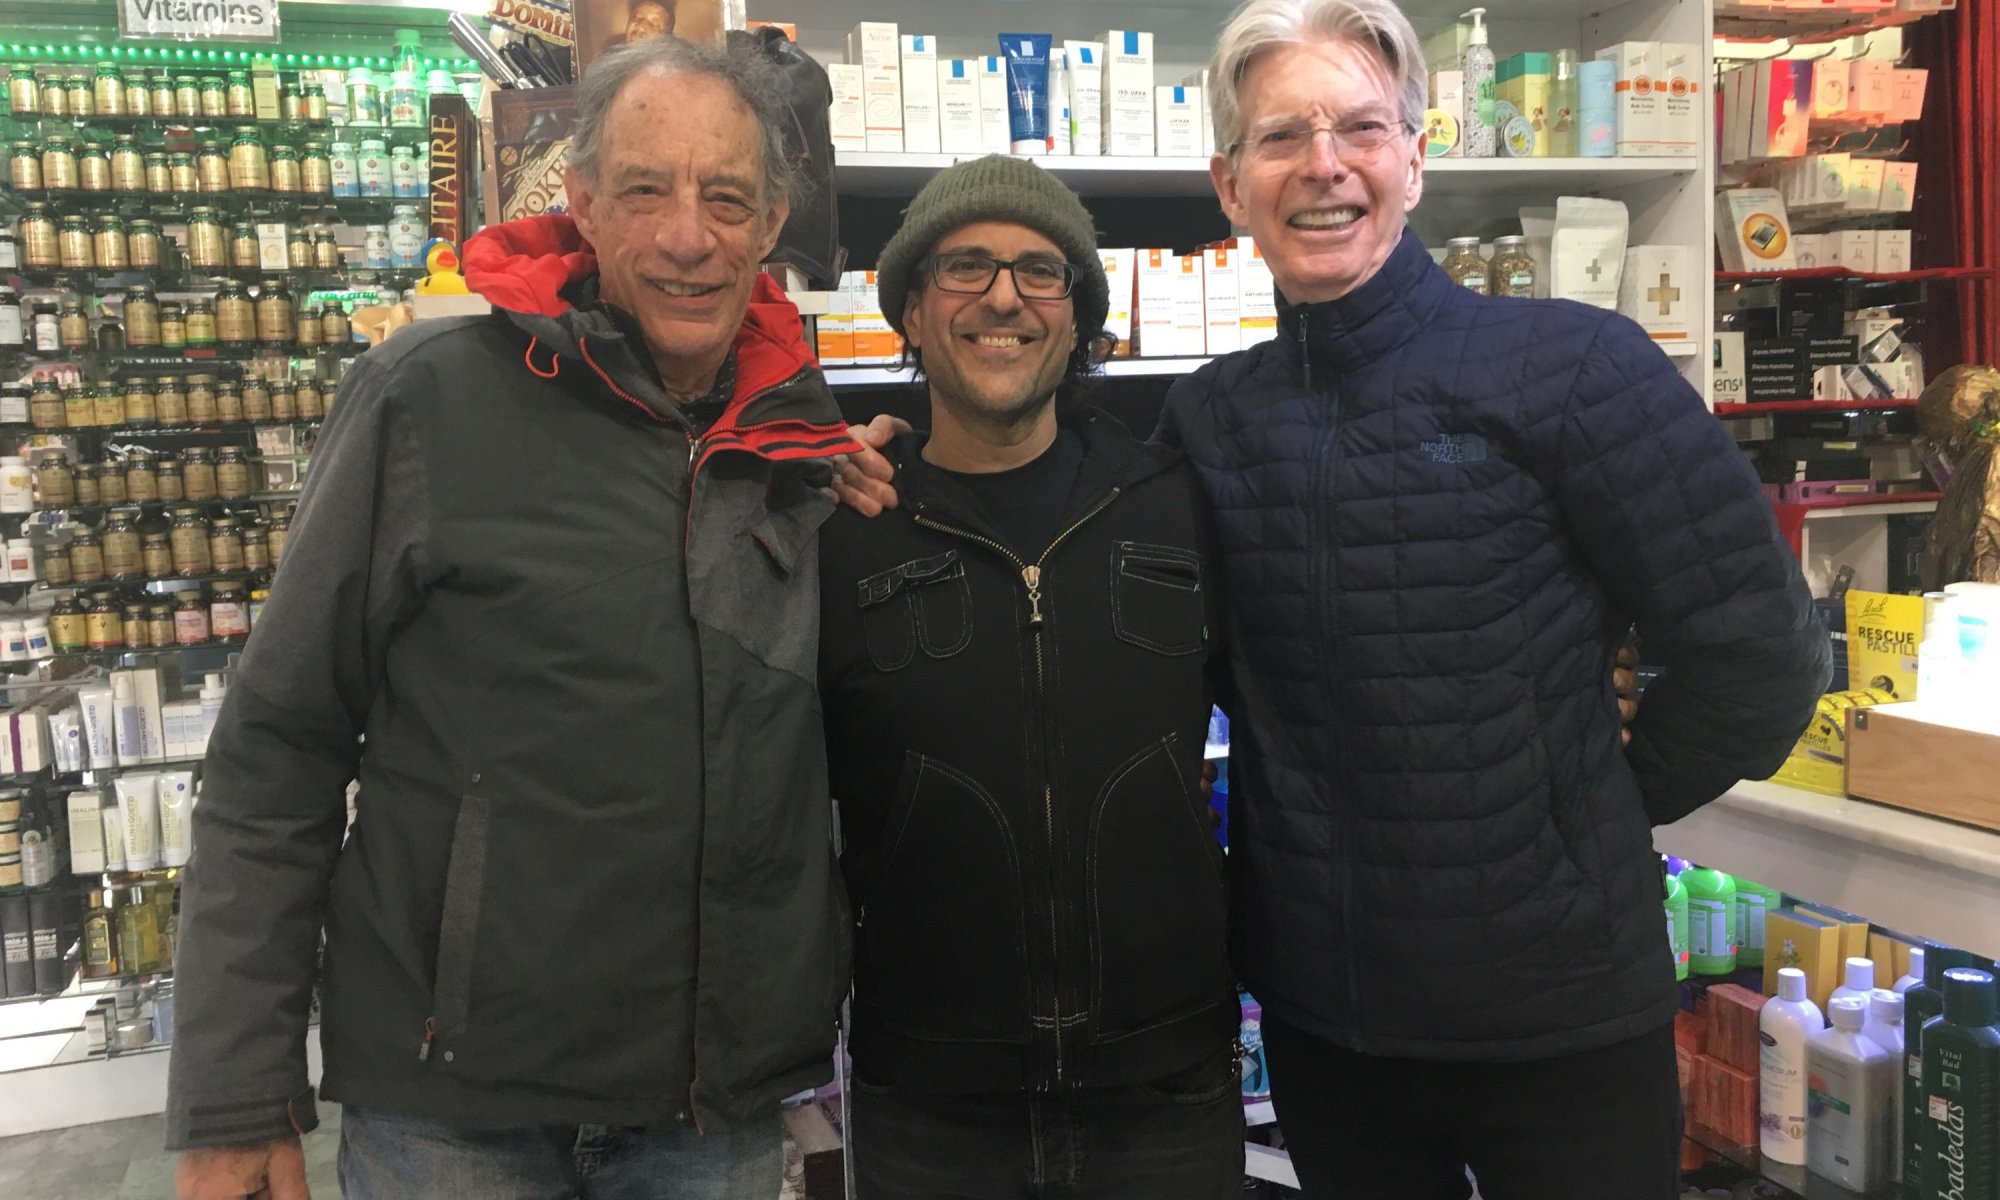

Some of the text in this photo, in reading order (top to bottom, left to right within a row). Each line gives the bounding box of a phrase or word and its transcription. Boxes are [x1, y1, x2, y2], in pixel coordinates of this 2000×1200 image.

[135, 0, 264, 25] Vitamins
[509, 146, 572, 221] POKE
[1420, 441, 1464, 453] NORTH
[1438, 433, 1465, 445] THE
[1432, 453, 1464, 464] FACE
[1858, 626, 1915, 644] RESCUE
[1867, 639, 1918, 657] PASTILL
[1802, 731, 1828, 745] ESCUE
[1940, 1048, 1962, 1061] Vital
[1937, 1101, 1965, 1200] badedas
